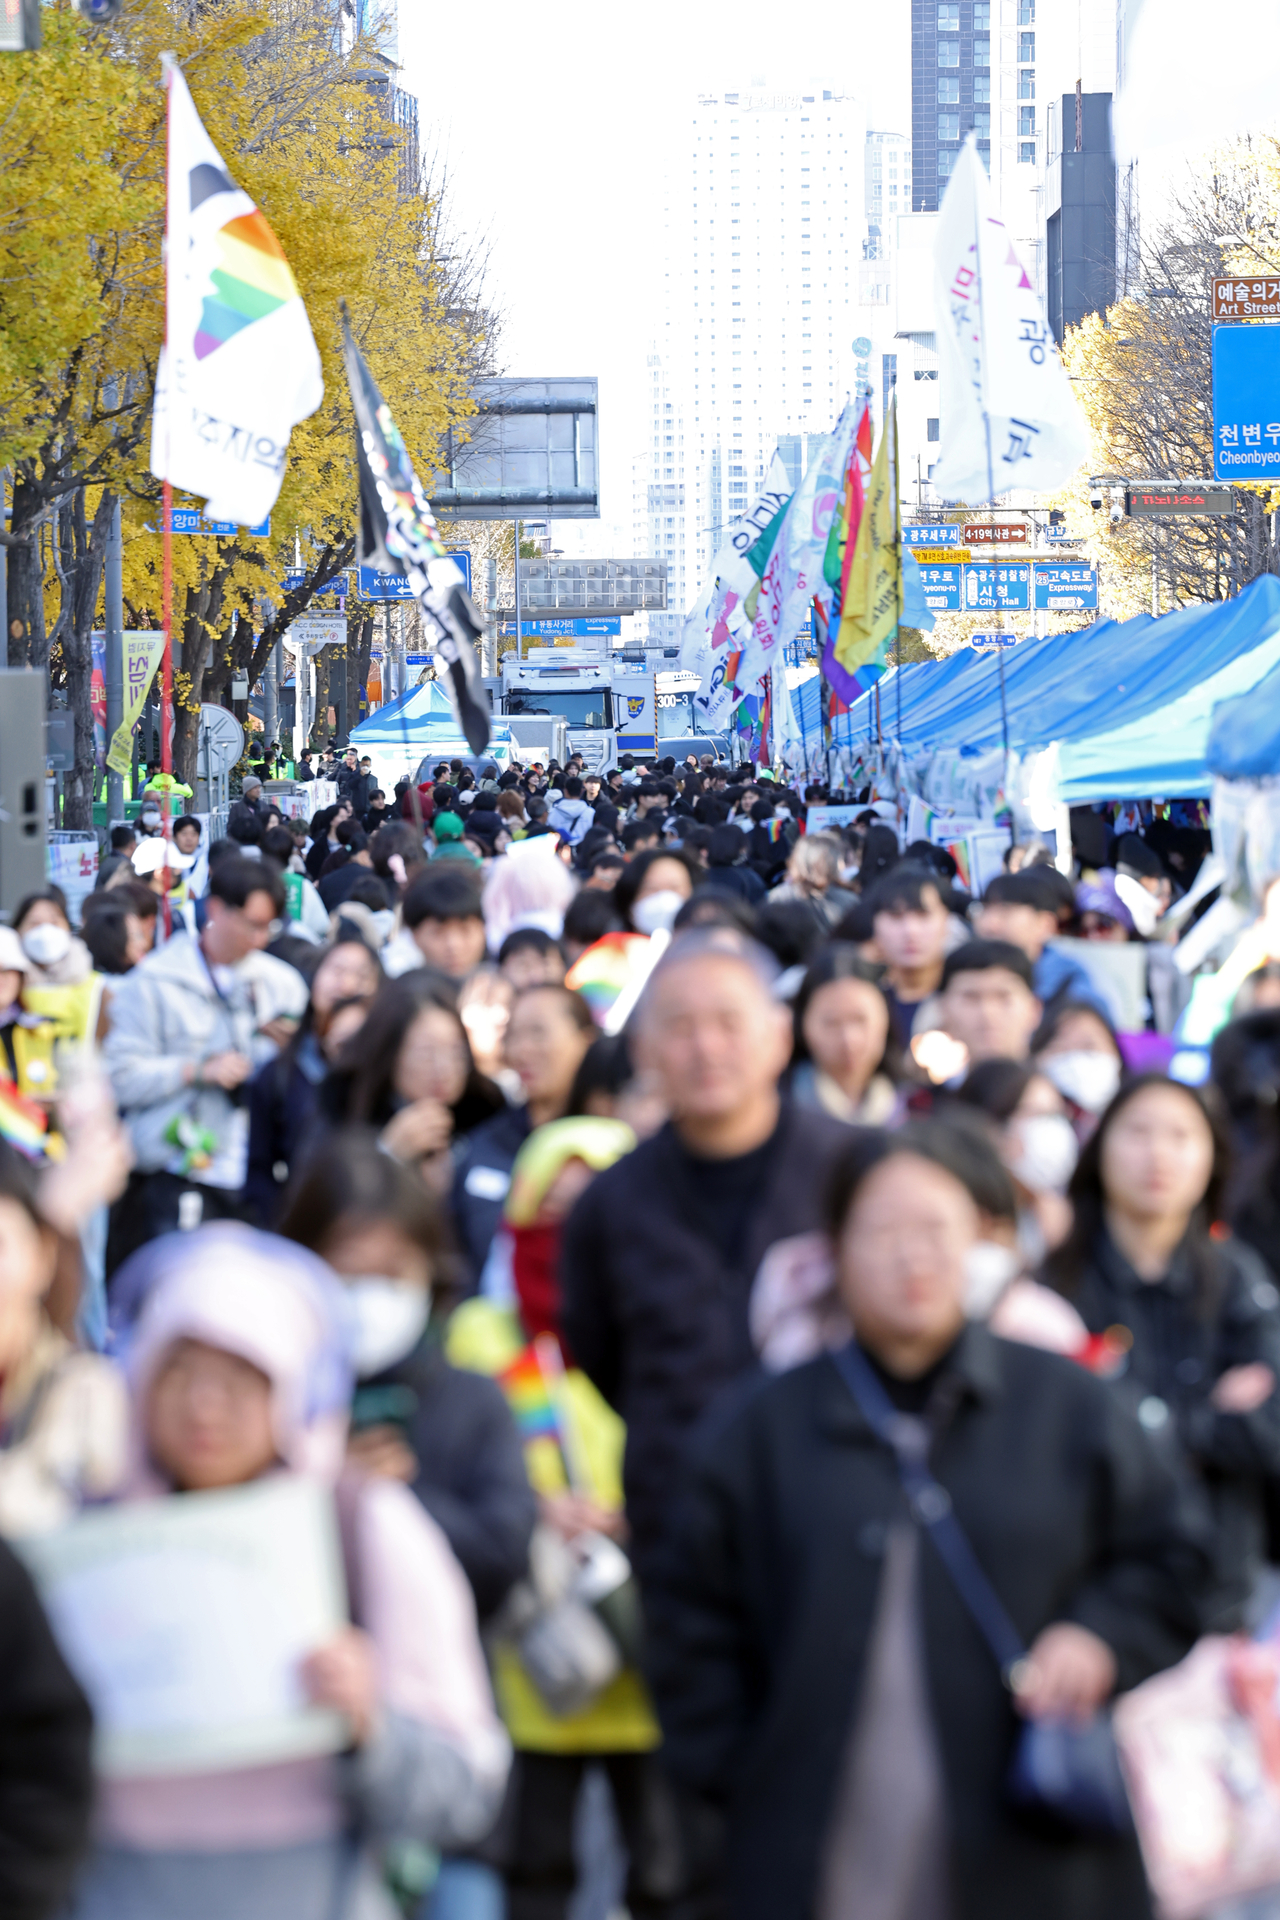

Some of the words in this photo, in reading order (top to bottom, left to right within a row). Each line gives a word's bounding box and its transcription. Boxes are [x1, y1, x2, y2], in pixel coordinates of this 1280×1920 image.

[1219, 302, 1239, 315] Art
[1219, 422, 1280, 447] 천변우
[1219, 449, 1280, 467] Cheonbyeo
[910, 529, 957, 542] 광주세무서
[978, 569, 1028, 582] 광주경찰청
[1049, 570, 1092, 582] 고속도로
[1048, 584, 1092, 592] Expressway
[979, 597, 998, 608] City
[1002, 597, 1020, 606] Hall
[539, 620, 574, 629] 유동사거리
[539, 628, 562, 636] Yudong
[657, 694, 689, 708] 300-3
